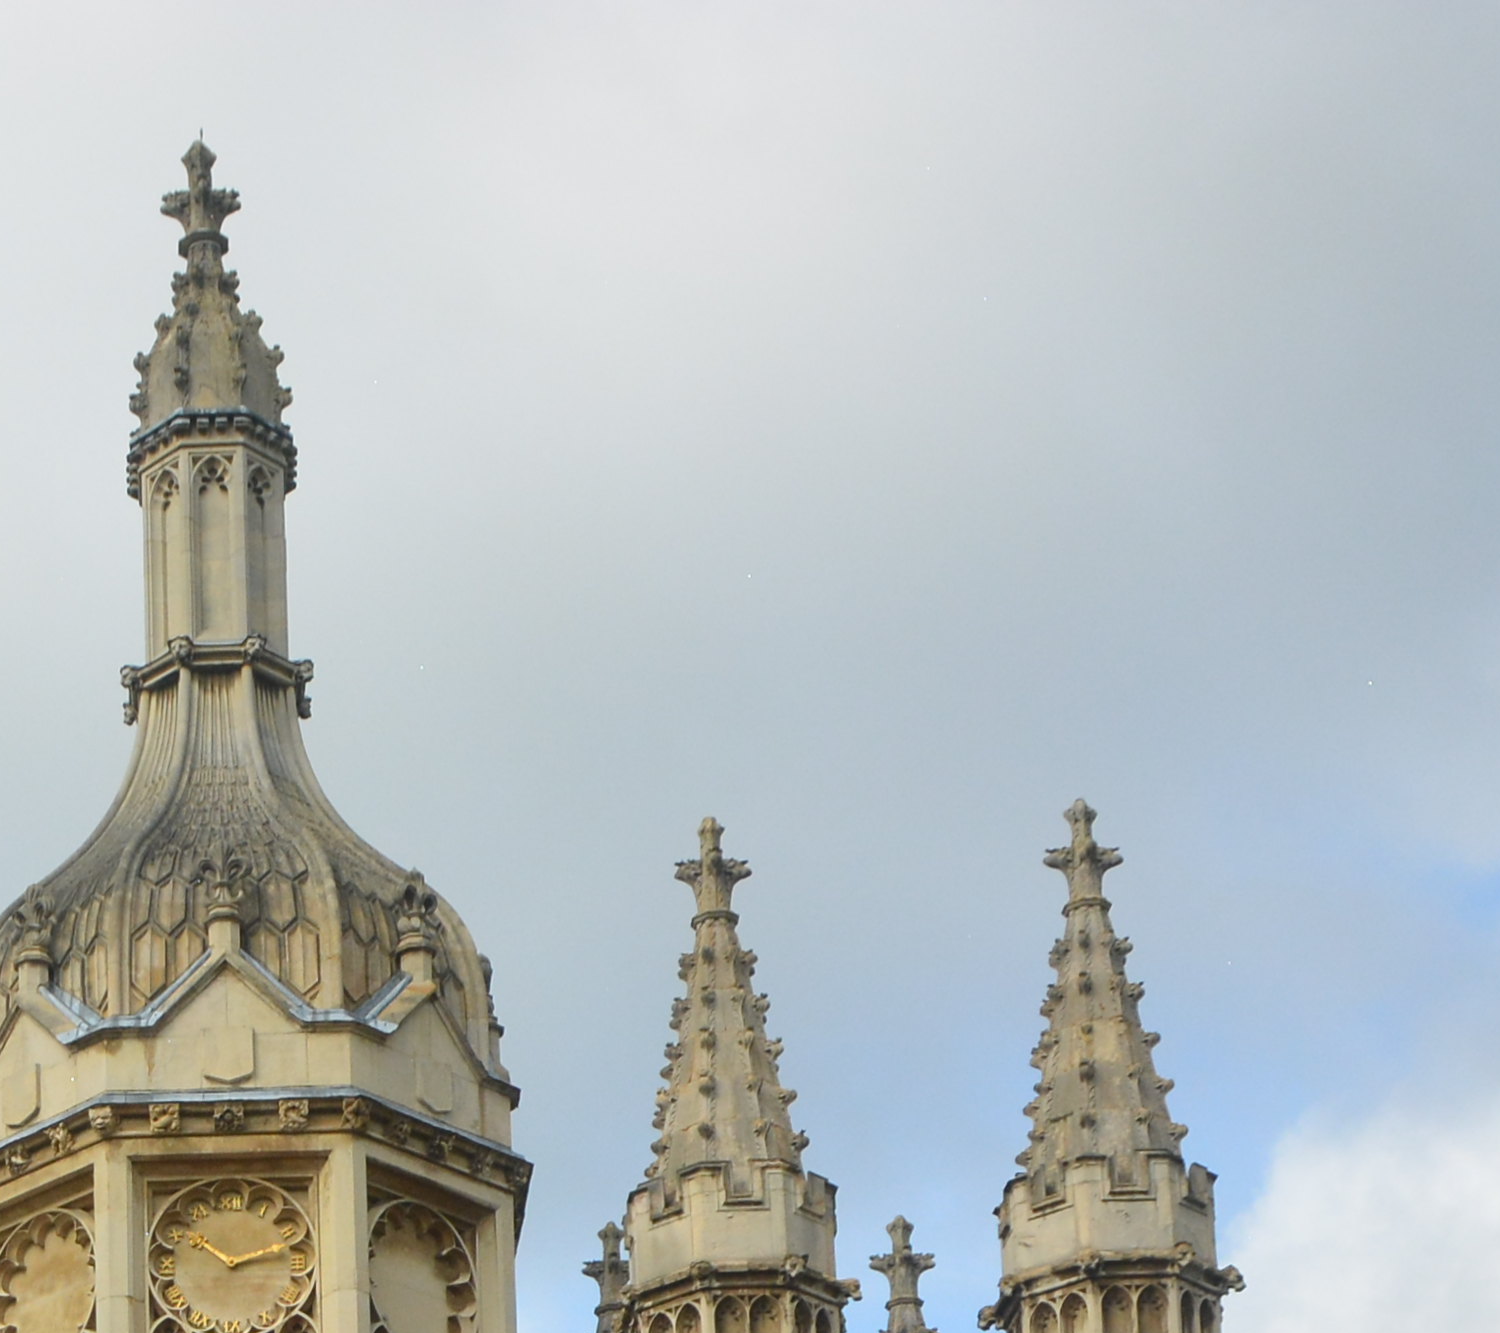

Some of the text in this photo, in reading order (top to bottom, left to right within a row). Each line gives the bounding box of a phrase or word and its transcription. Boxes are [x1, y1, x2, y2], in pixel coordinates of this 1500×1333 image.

[220, 1196, 242, 1211] XII
[279, 1224, 297, 1240] II
[290, 1254, 307, 1273] III
